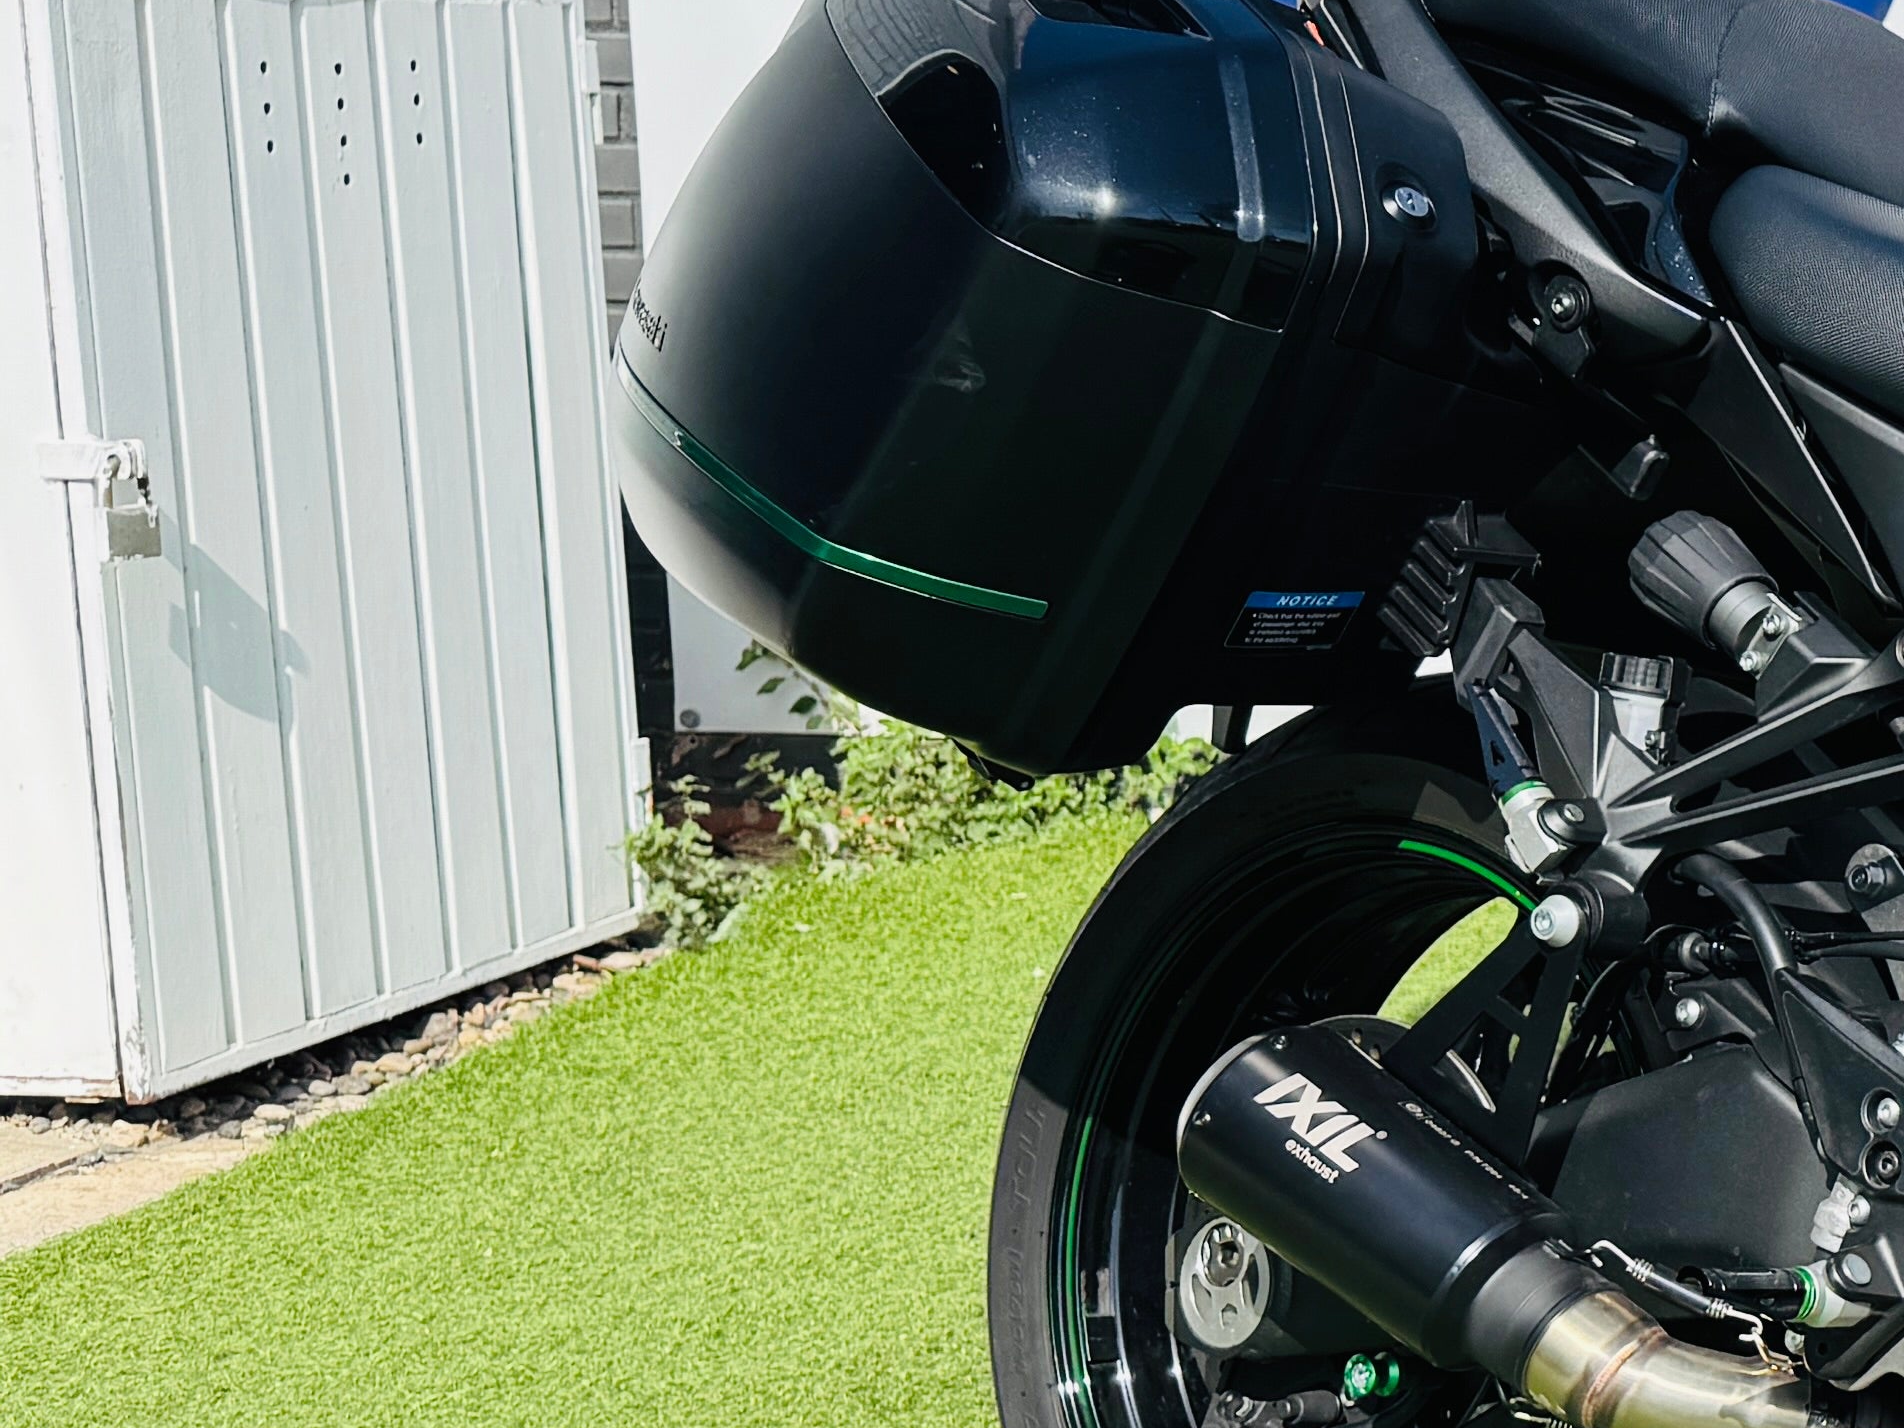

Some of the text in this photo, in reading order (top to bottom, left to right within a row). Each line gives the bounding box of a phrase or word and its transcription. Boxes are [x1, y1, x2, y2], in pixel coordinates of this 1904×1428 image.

[1275, 594, 1339, 607] NOTICE
[1252, 1072, 1376, 1173] IXIL
[1284, 1139, 1341, 1184] exhaust
